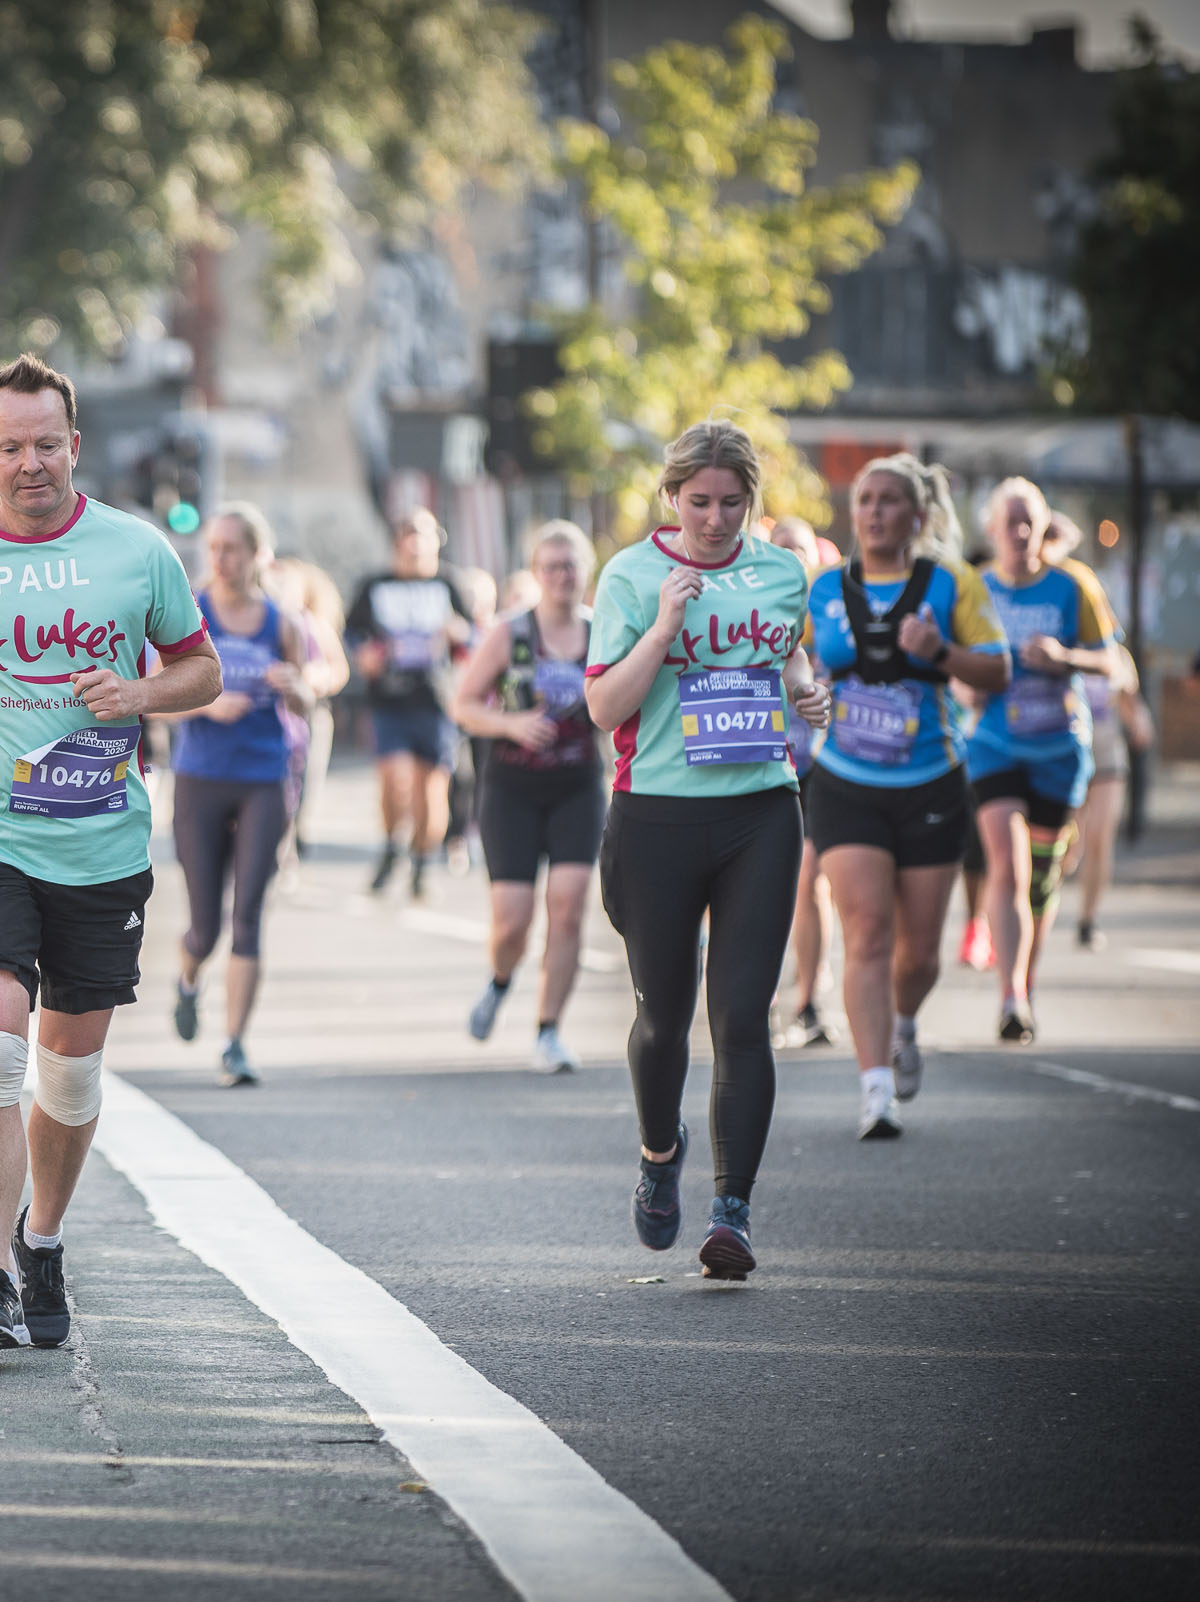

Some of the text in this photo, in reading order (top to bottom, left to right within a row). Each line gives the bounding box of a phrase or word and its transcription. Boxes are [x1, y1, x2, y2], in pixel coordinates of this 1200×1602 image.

[702, 566, 765, 593] ATE
[13, 607, 126, 664] Luke's
[753, 689, 772, 697] 2020
[0, 696, 88, 711] Sheffield's Hos
[703, 711, 769, 733] 10477
[69, 731, 98, 740] FFIELD
[77, 738, 128, 749] MARATHON
[104, 746, 126, 756] 2020
[39, 763, 112, 788] 10476
